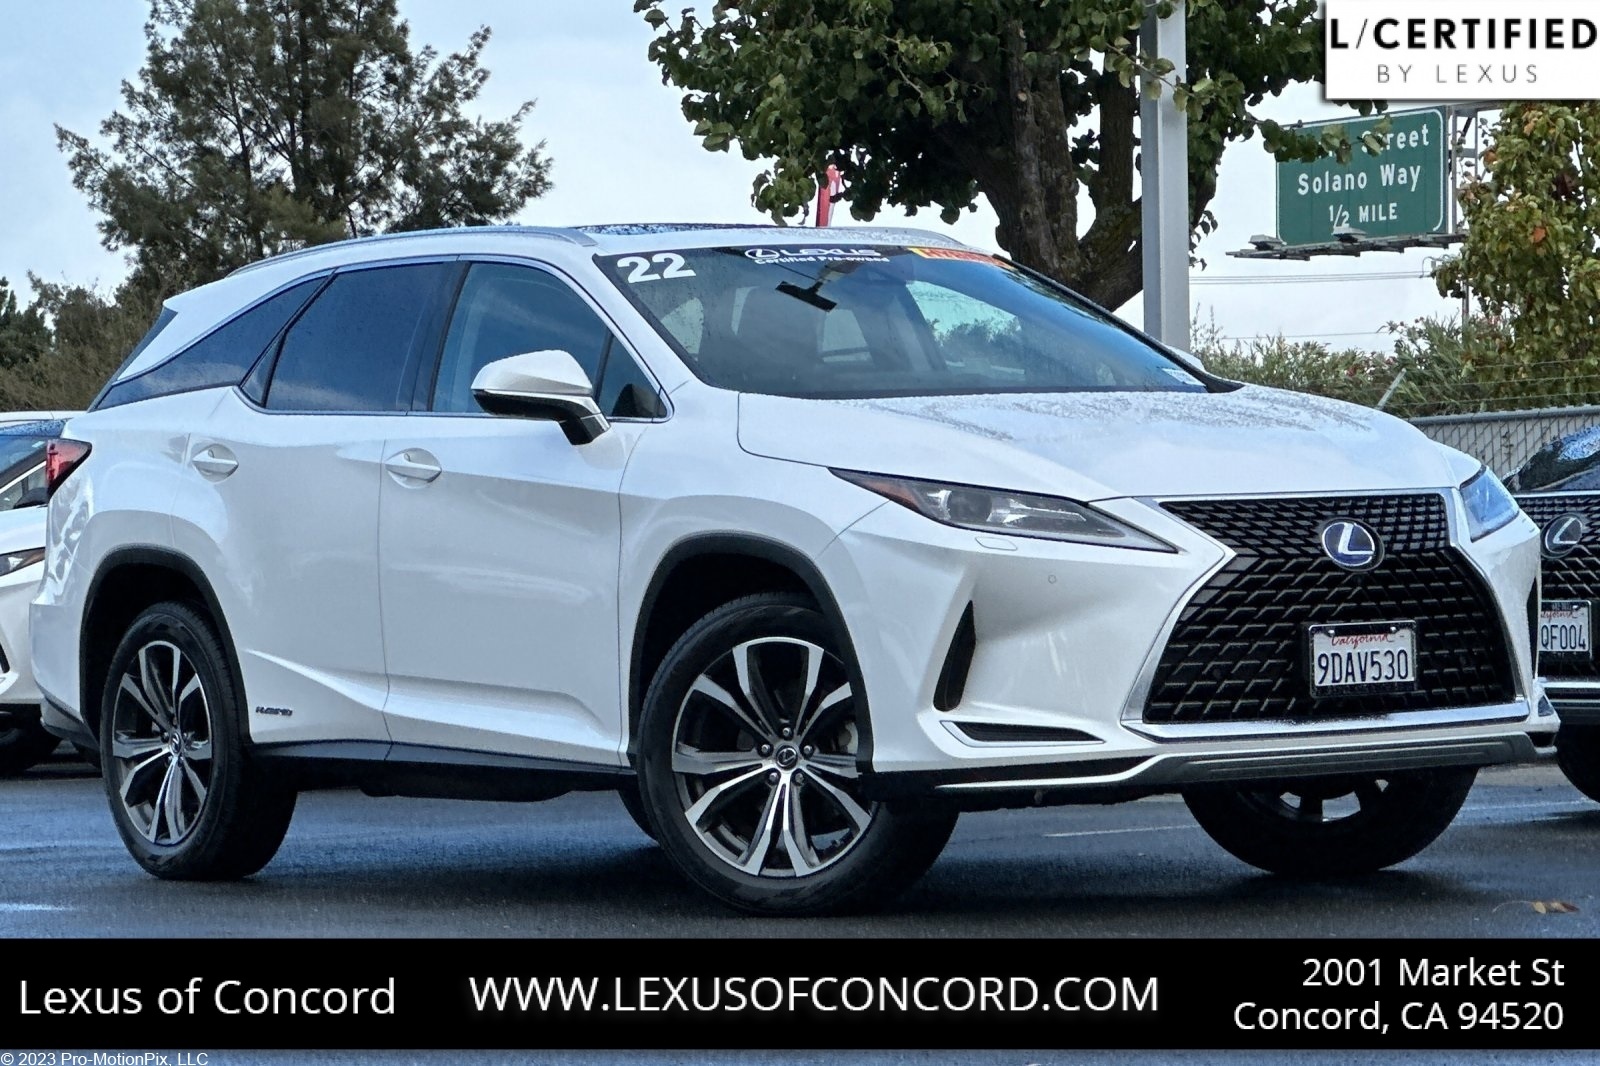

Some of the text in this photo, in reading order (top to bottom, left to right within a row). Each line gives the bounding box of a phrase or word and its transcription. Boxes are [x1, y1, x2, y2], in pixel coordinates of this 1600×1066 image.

[1361, 124, 1430, 153] reet
[1297, 163, 1421, 196] Solano Way
[1358, 202, 1398, 223] MILE
[616, 252, 697, 284] 22
[1331, 632, 1395, 649] California
[1540, 624, 1587, 650] QF004
[1317, 649, 1409, 685] 9DAV530
